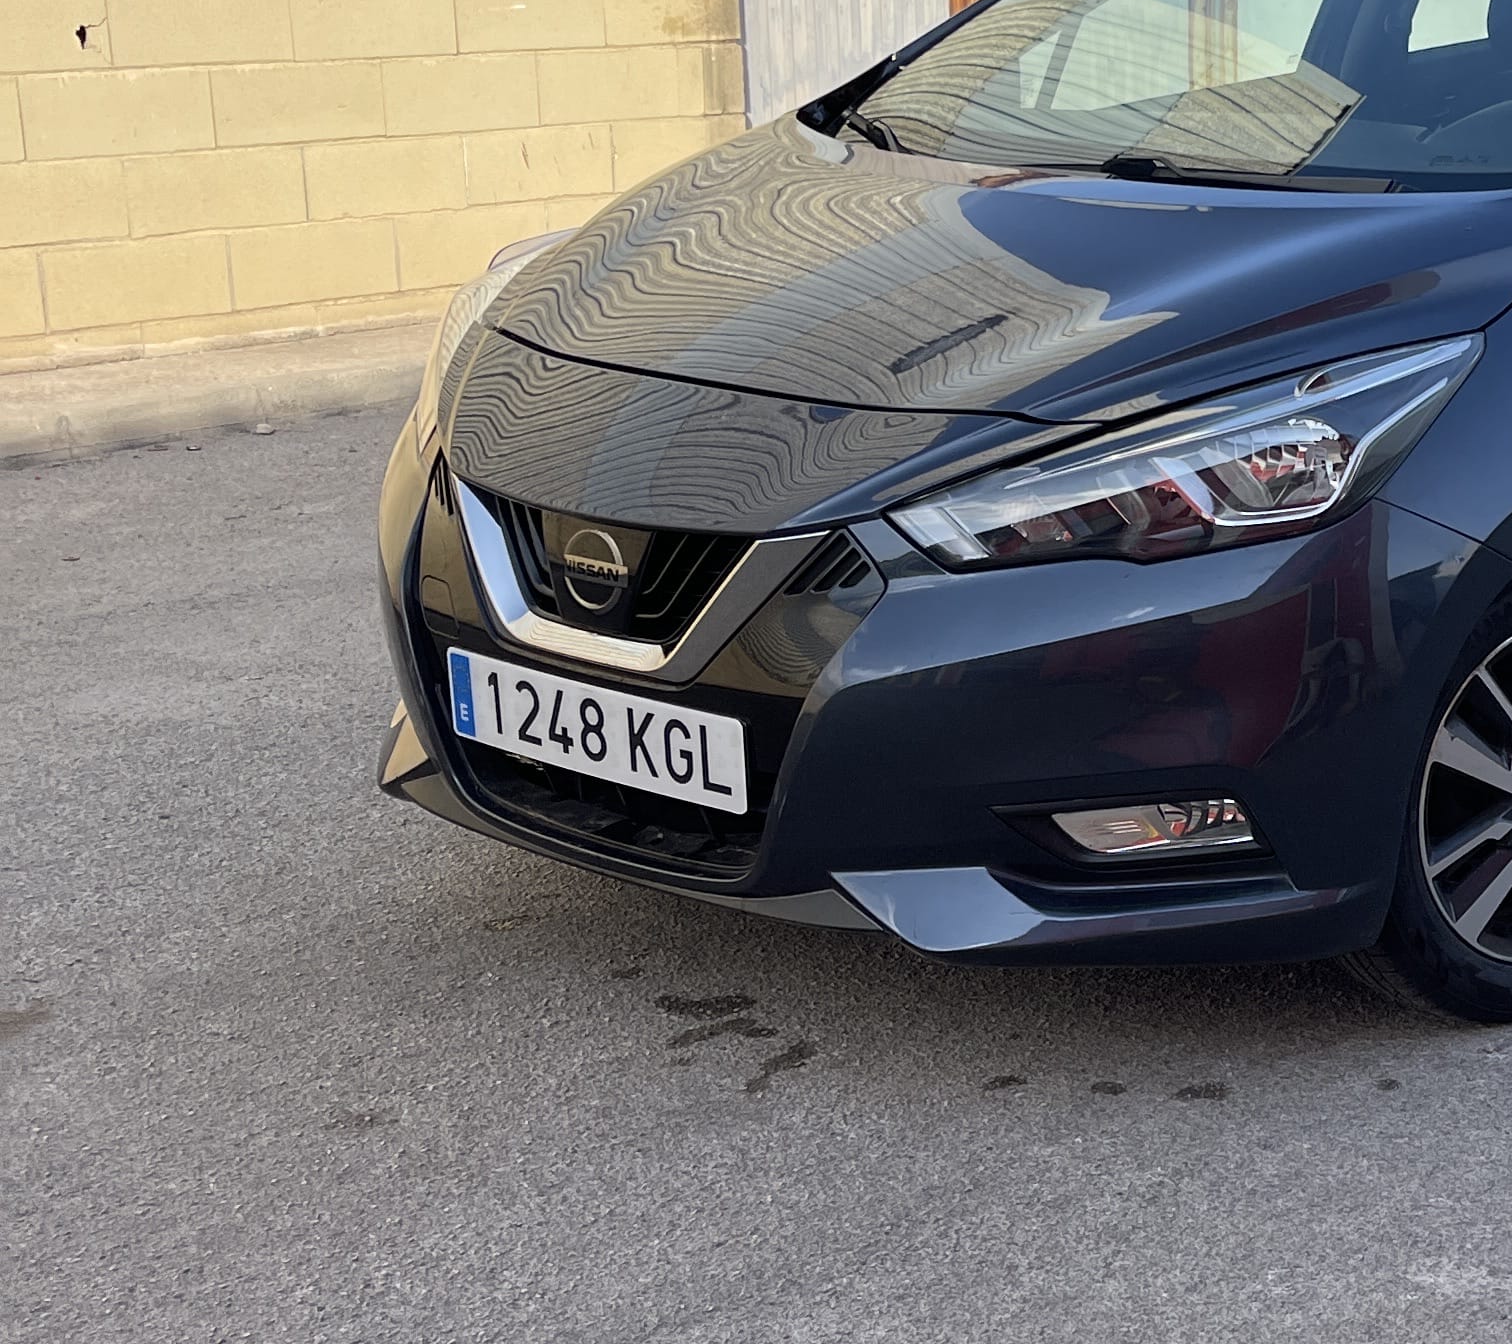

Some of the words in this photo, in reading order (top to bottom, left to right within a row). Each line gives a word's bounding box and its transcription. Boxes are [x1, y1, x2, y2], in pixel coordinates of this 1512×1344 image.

[564, 558, 619, 583] NISSAN
[460, 702, 470, 723] E
[488, 671, 607, 762] 1248
[627, 707, 733, 796] KGL
